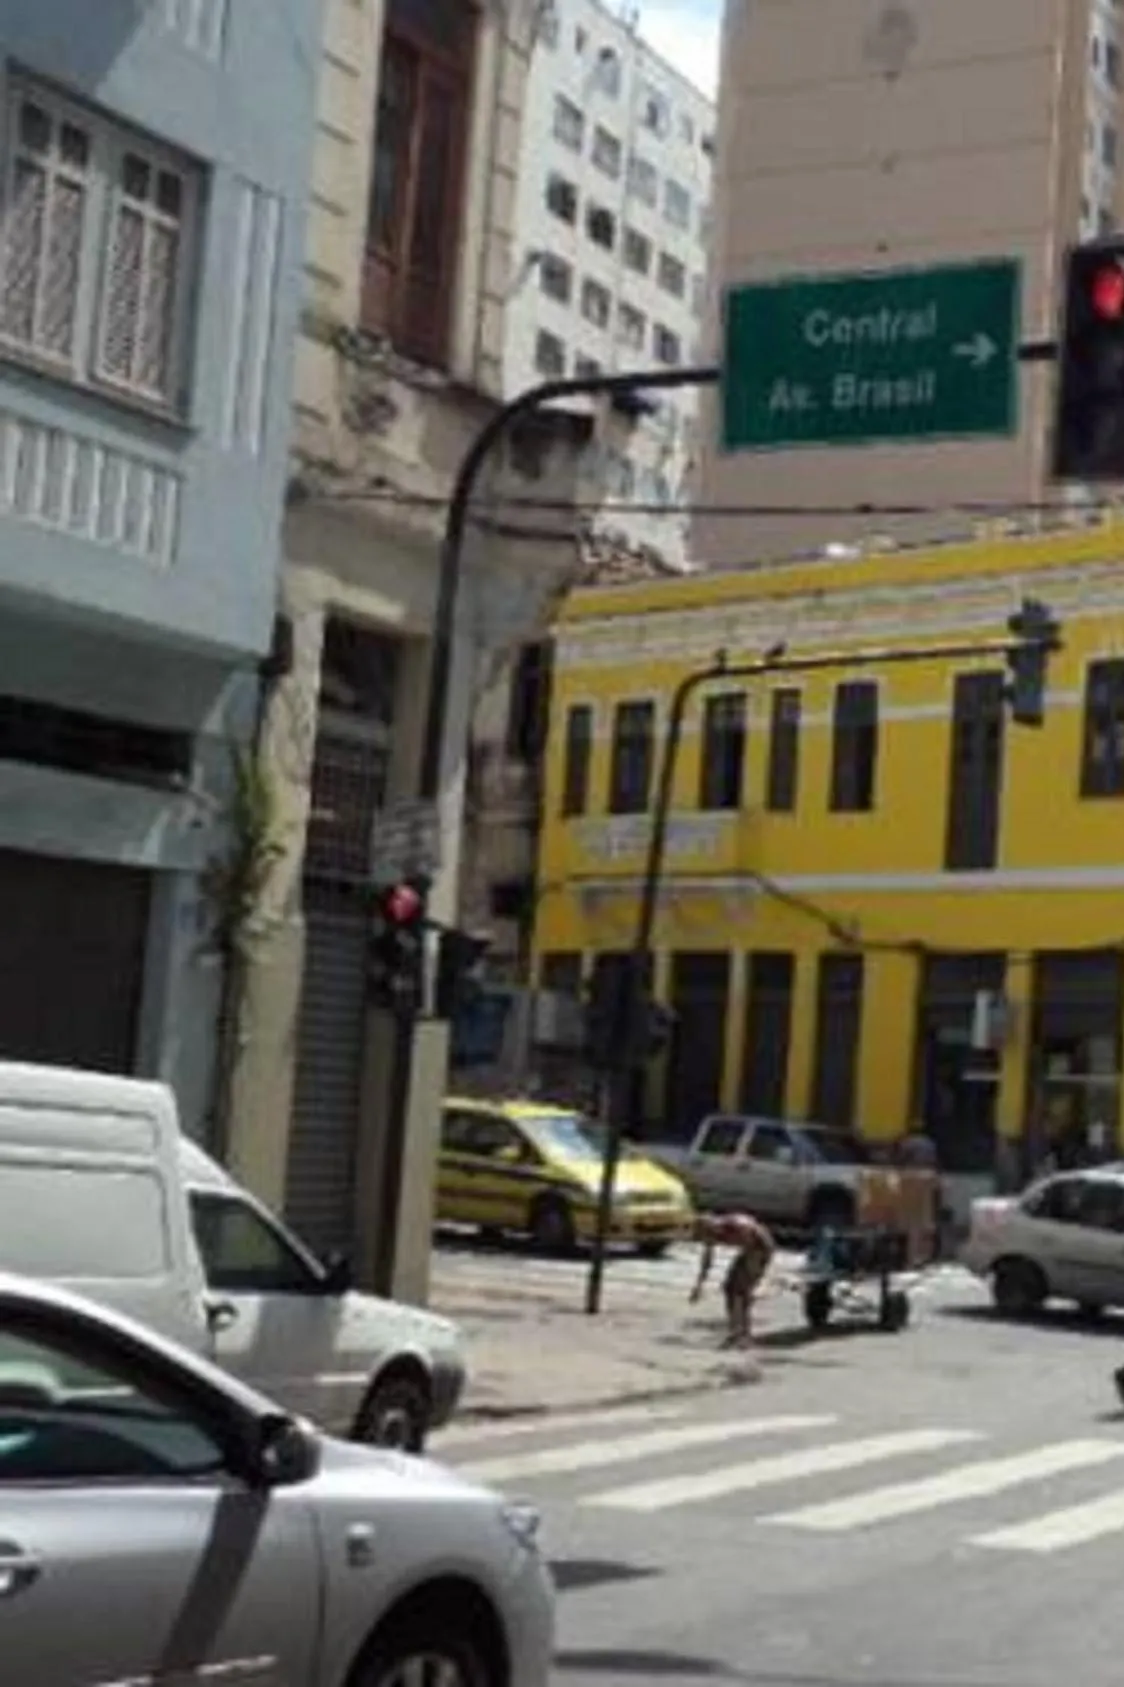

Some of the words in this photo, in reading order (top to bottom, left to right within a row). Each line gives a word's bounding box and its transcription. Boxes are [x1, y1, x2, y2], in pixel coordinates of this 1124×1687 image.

[804, 302, 936, 346] Central
[769, 377, 819, 412] Av.
[832, 371, 935, 411] Brasil
